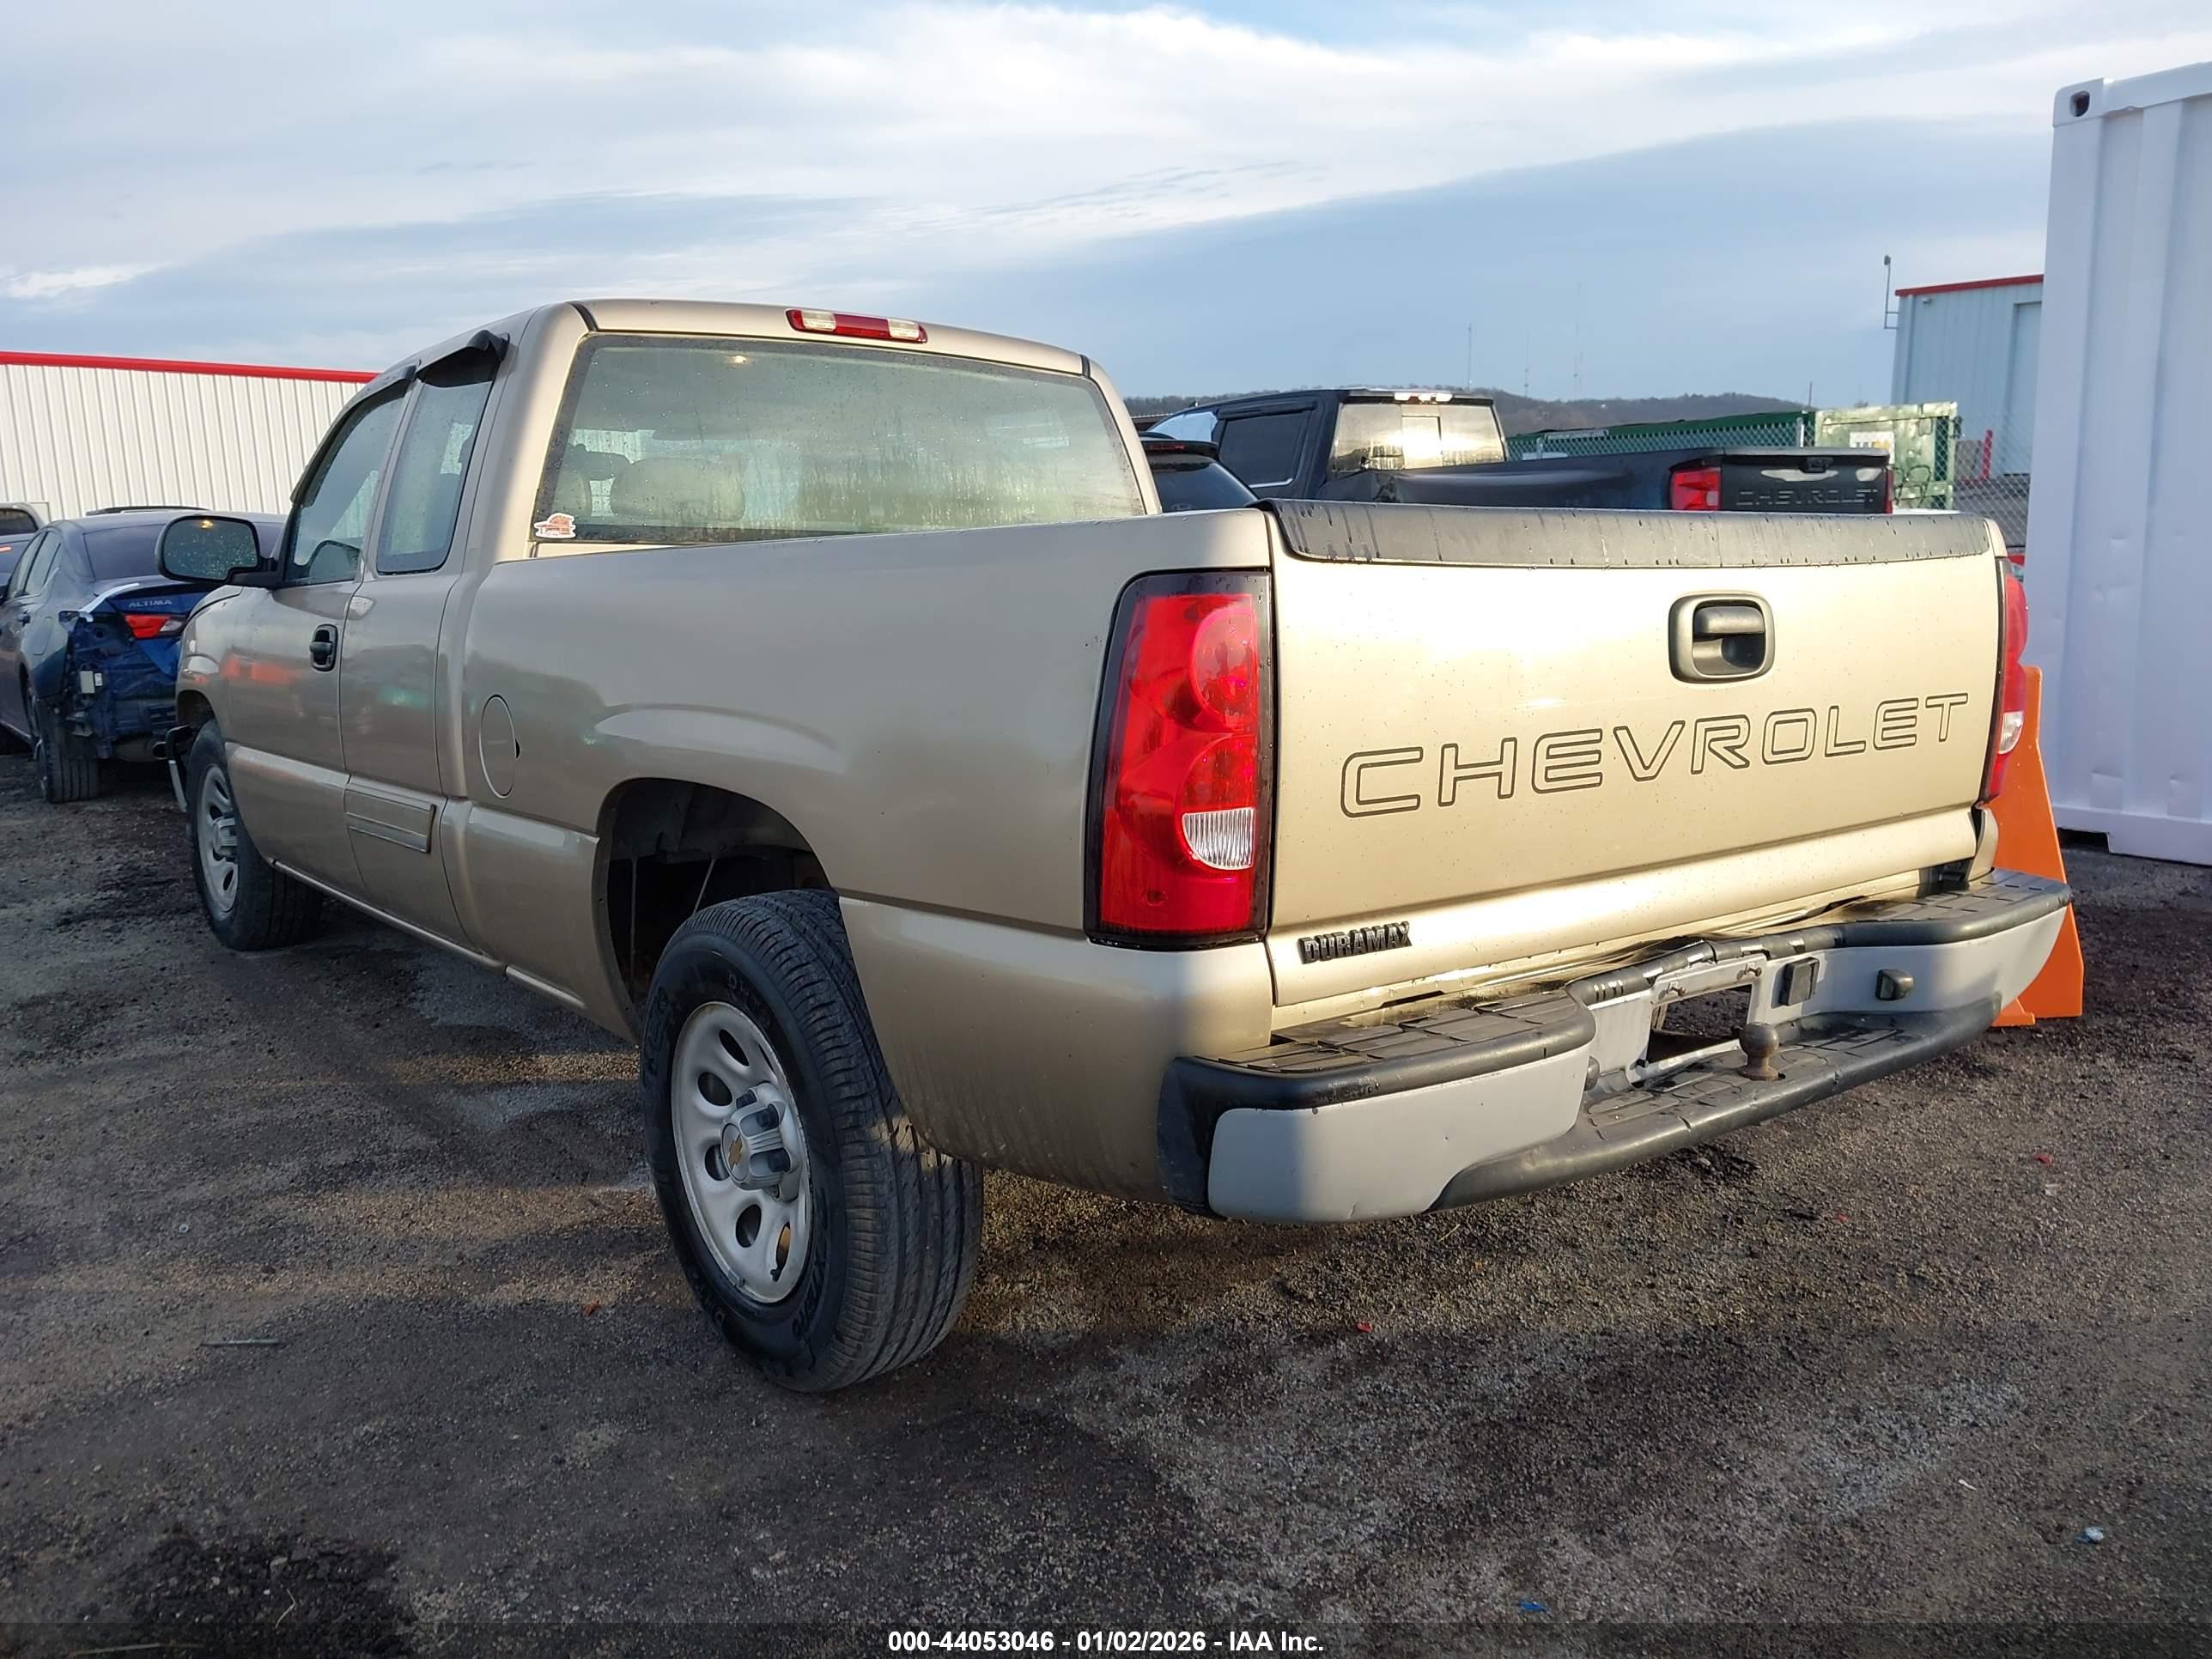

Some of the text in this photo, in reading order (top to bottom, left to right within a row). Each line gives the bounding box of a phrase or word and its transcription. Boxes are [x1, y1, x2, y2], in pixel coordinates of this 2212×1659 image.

[129, 599, 173, 609] ALTIMA
[1340, 692, 1969, 818] CHEVROLET
[1297, 921, 1413, 965] DURAMAX
